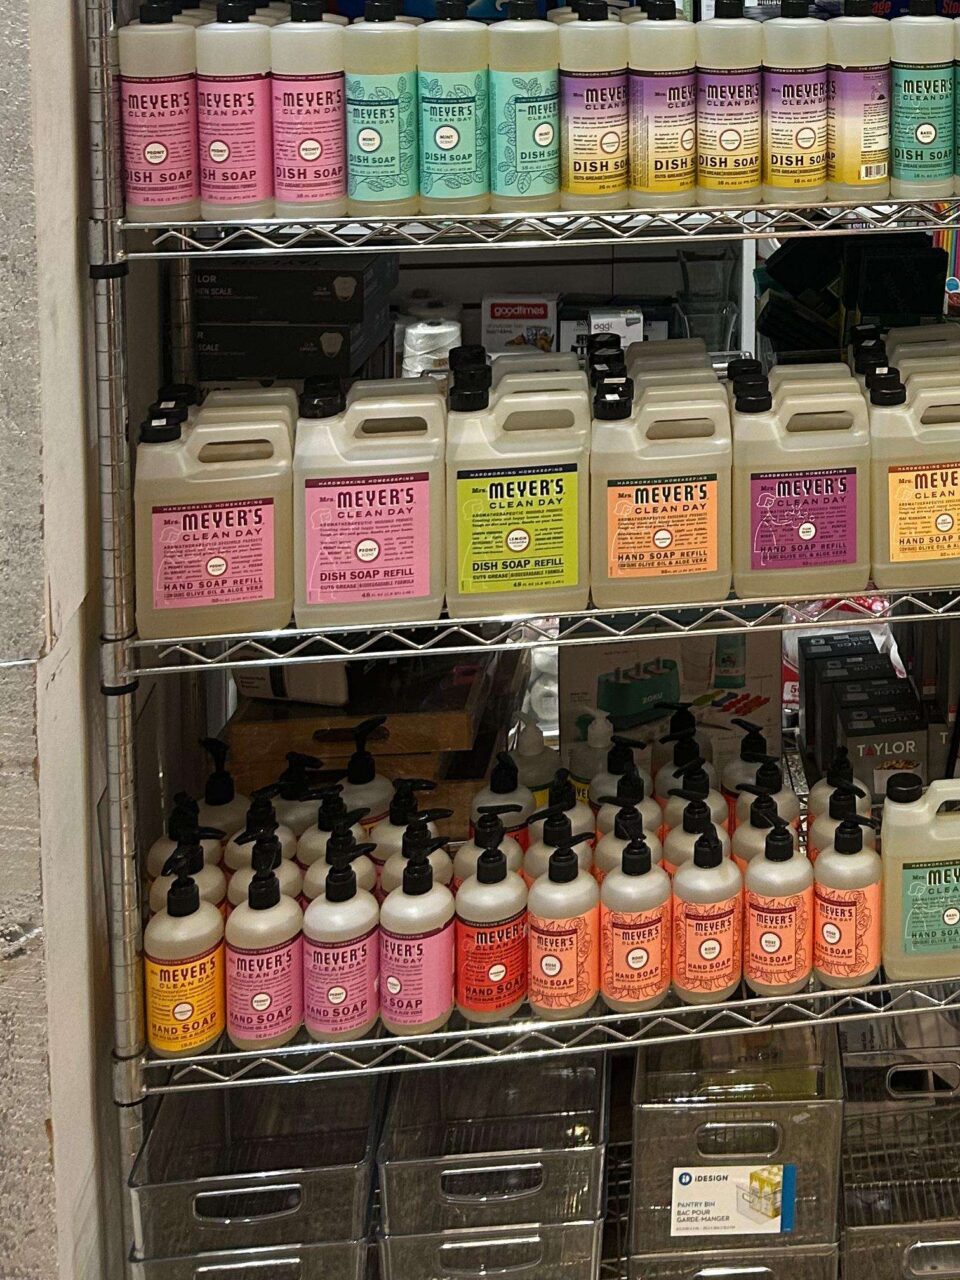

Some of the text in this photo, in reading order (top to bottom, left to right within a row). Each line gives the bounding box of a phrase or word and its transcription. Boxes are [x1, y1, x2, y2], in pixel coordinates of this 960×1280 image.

[706, 83, 759, 100] MEYER'S
[128, 92, 190, 109] MEYER'S
[429, 106, 472, 117] MEYER'S
[159, 170, 192, 182] SOAP
[494, 303, 545, 318] goodtimes
[489, 478, 564, 499] MEYER'S
[776, 477, 847, 497] MEYER'S
[337, 487, 415, 508] MEYER'S
[337, 507, 414, 519] CLEAN DAY
[617, 553, 645, 561] HAND
[649, 551, 676, 560] SOAP
[320, 568, 414, 582] DISH SOAP REFILL
[164, 577, 263, 592] HAND SOAP REFILL
[856, 740, 916, 757] TAYLOR
[159, 957, 216, 983] MEYER'S
[676, 1215, 730, 1223] GARDE-MANGER
